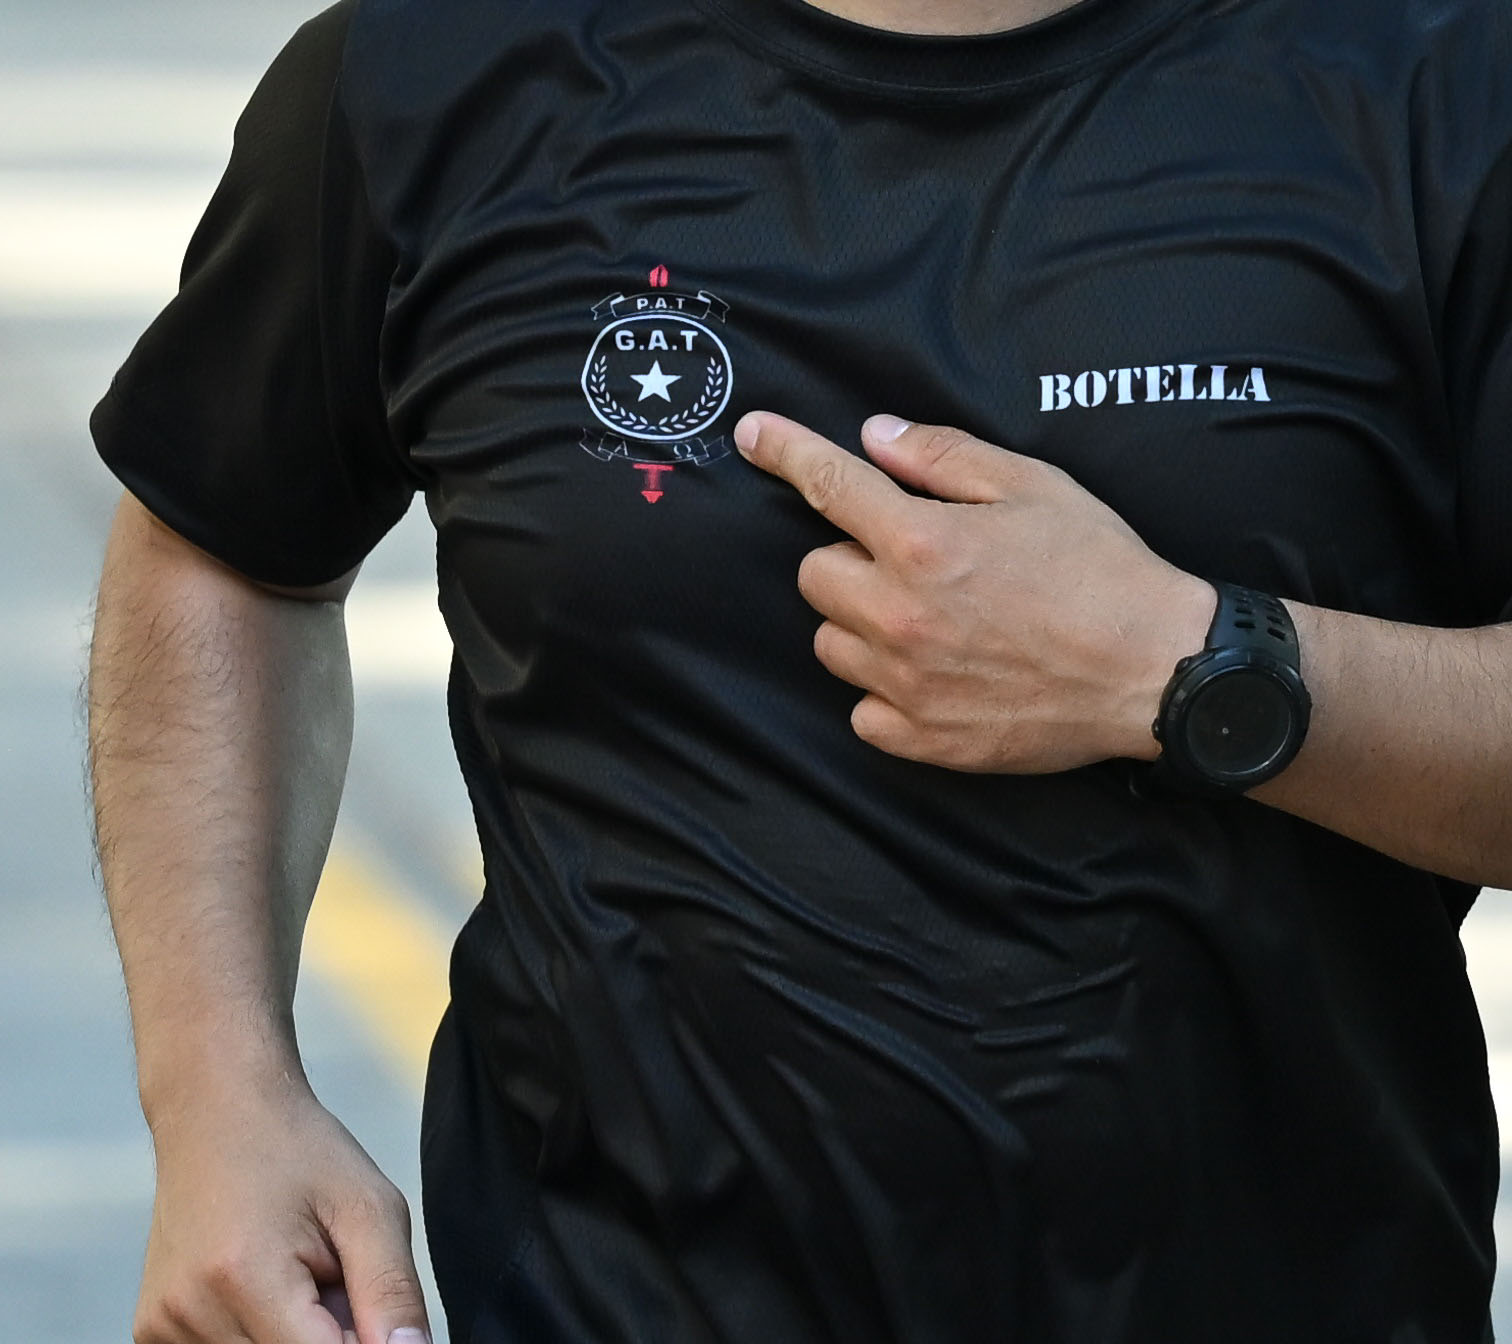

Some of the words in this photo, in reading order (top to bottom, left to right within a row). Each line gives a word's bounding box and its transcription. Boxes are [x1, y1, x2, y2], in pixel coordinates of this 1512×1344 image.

[636, 297, 686, 311] P.A.T
[615, 329, 699, 352] G.A.T
[1039, 364, 1272, 412] BOTELLA
